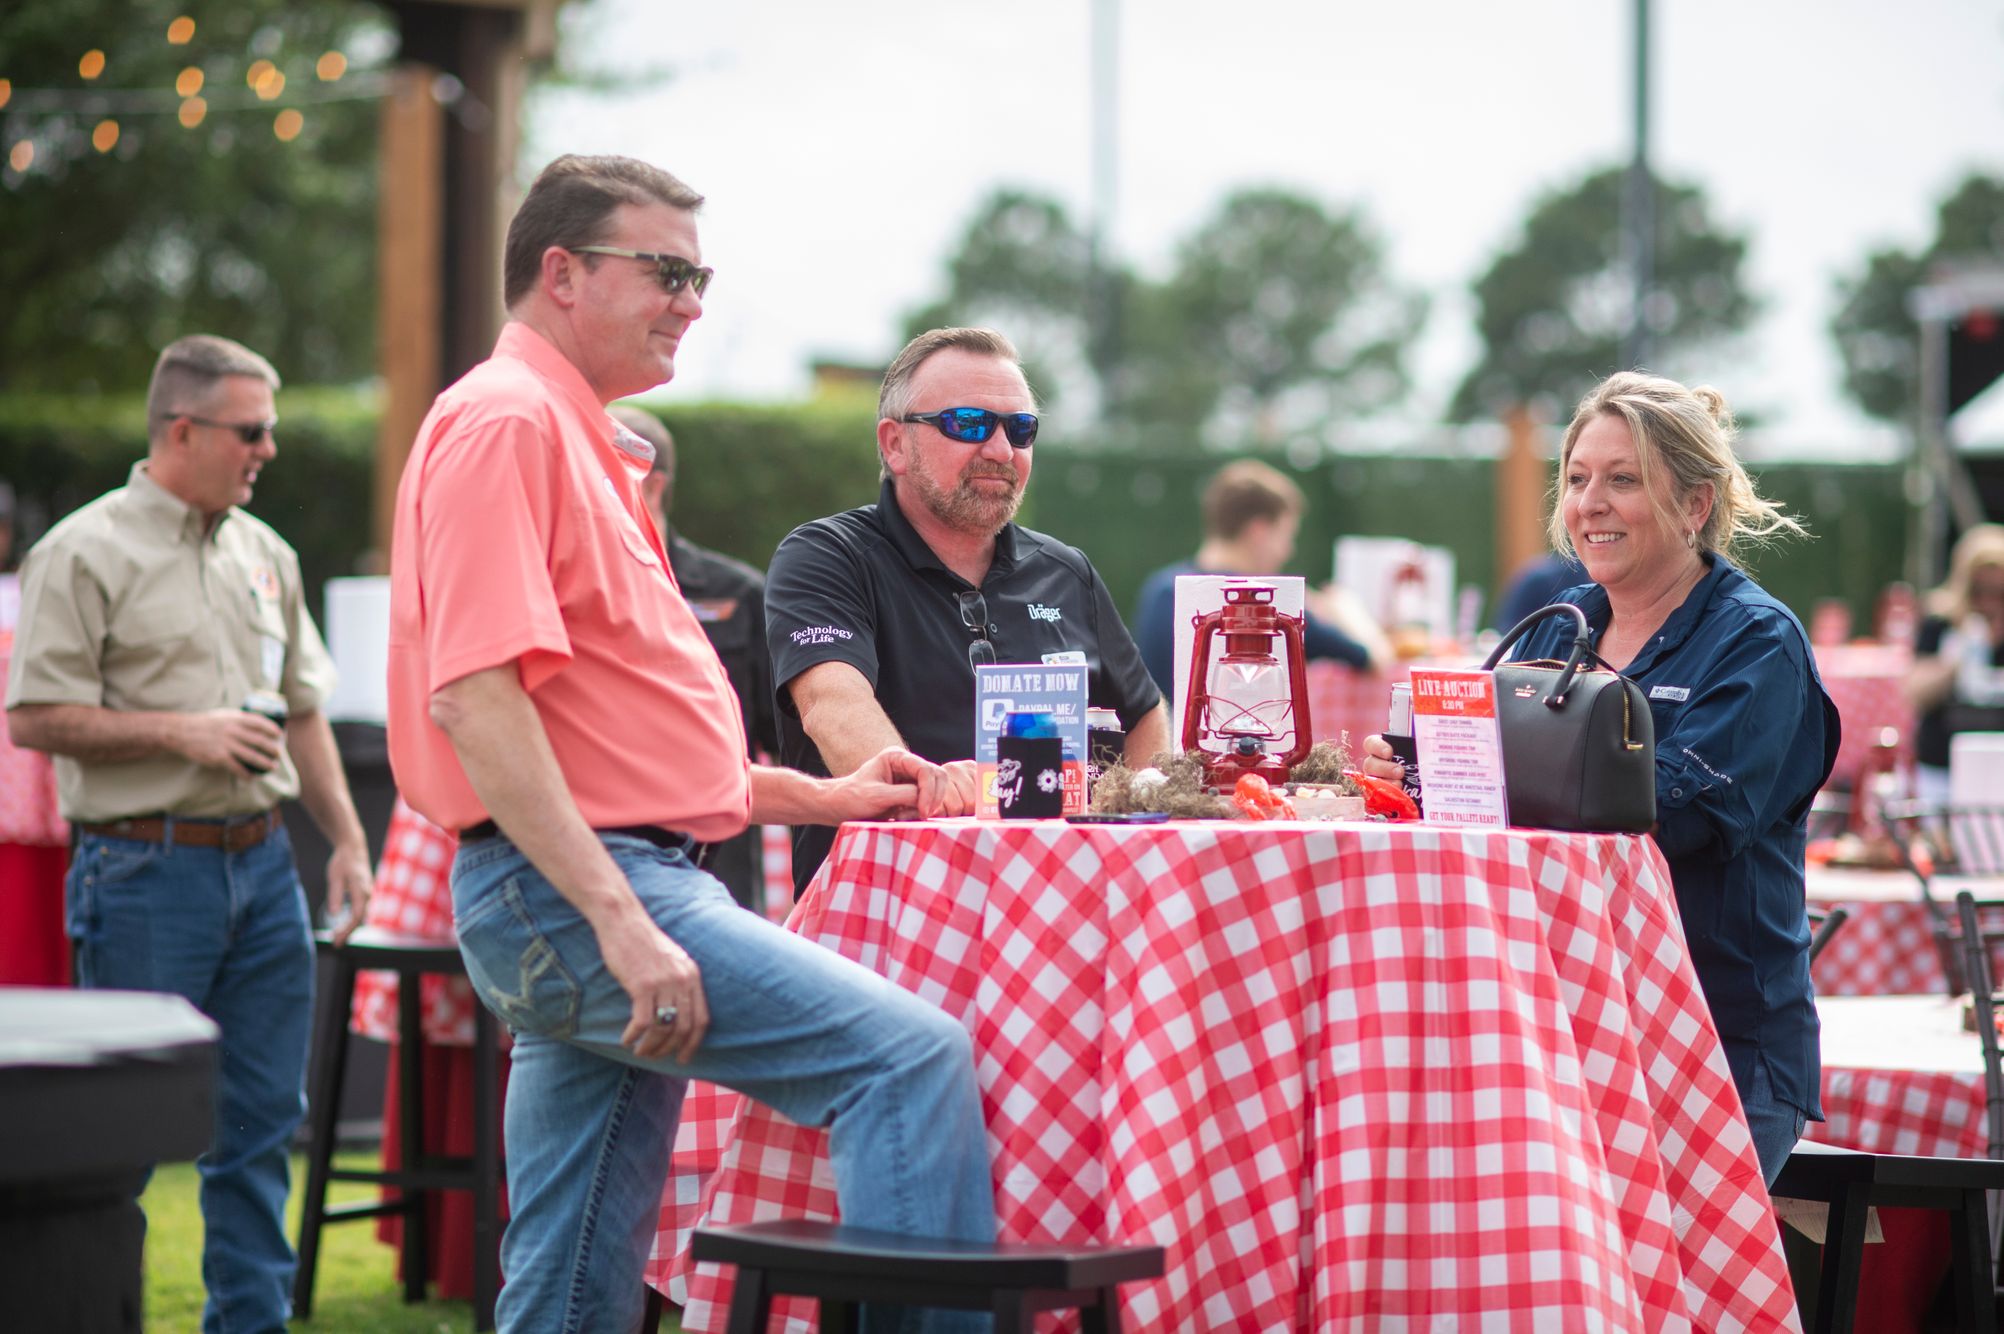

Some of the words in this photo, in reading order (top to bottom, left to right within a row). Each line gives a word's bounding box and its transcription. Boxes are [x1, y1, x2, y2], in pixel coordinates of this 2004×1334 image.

[1028, 604, 1062, 622] Dräger
[790, 625, 853, 640] Technology
[800, 637, 810, 645] for
[811, 634, 834, 644] Life
[982, 675, 1041, 693] DONATE
[1046, 673, 1080, 692] NOW
[1417, 679, 1441, 696] LIVE
[1443, 680, 1486, 698] AUCTION
[1683, 748, 1733, 784] OMNI-SHADE
[1429, 811, 1439, 821] GET
[1440, 812, 1455, 822] YOUR
